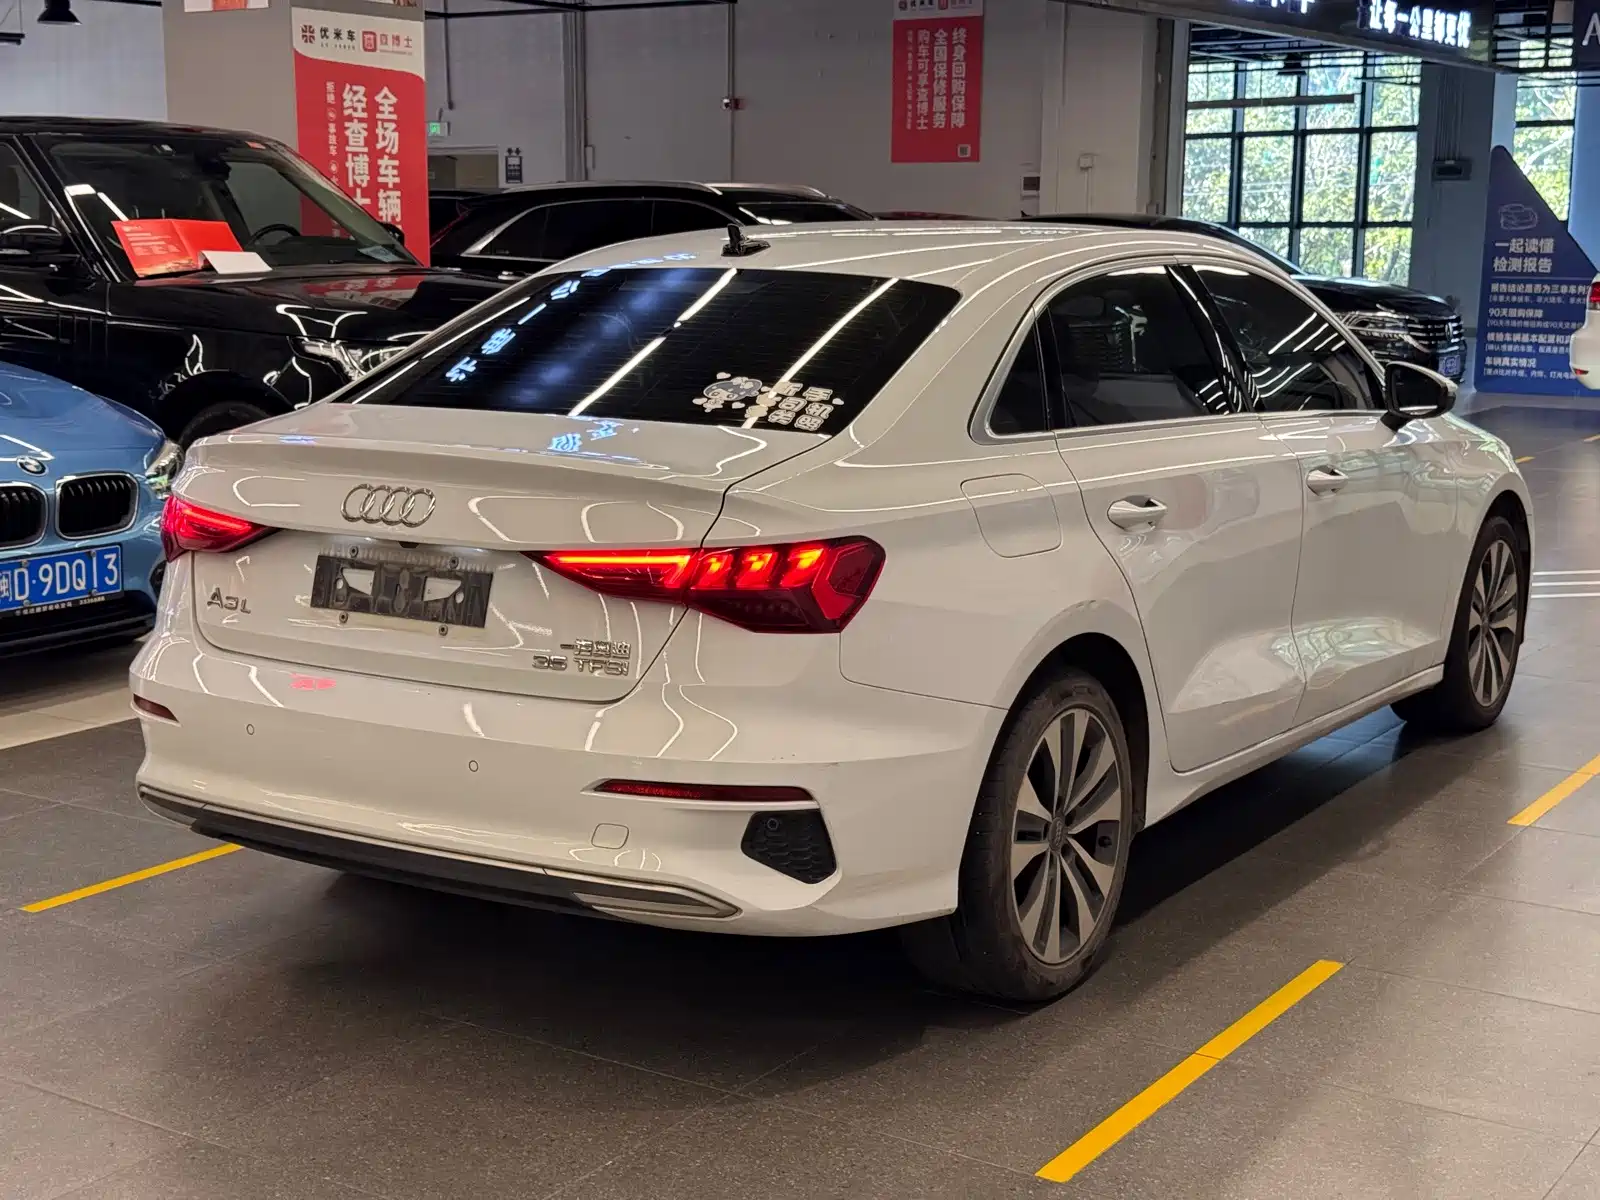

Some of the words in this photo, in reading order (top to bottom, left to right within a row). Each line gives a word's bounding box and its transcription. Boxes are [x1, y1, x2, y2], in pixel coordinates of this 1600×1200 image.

[319, 26, 356, 42] 优米车
[916, 29, 930, 130] 购车可享查博士
[933, 29, 948, 128] 全国保修服务
[952, 28, 966, 128] 终身回购保障
[374, 86, 403, 231] 全场车辆
[1494, 238, 1554, 254] 一起读懂
[1493, 257, 1553, 273] 检测报告
[207, 587, 251, 614] A3L
[532, 654, 568, 672] 35
[573, 657, 630, 676] TFSI
